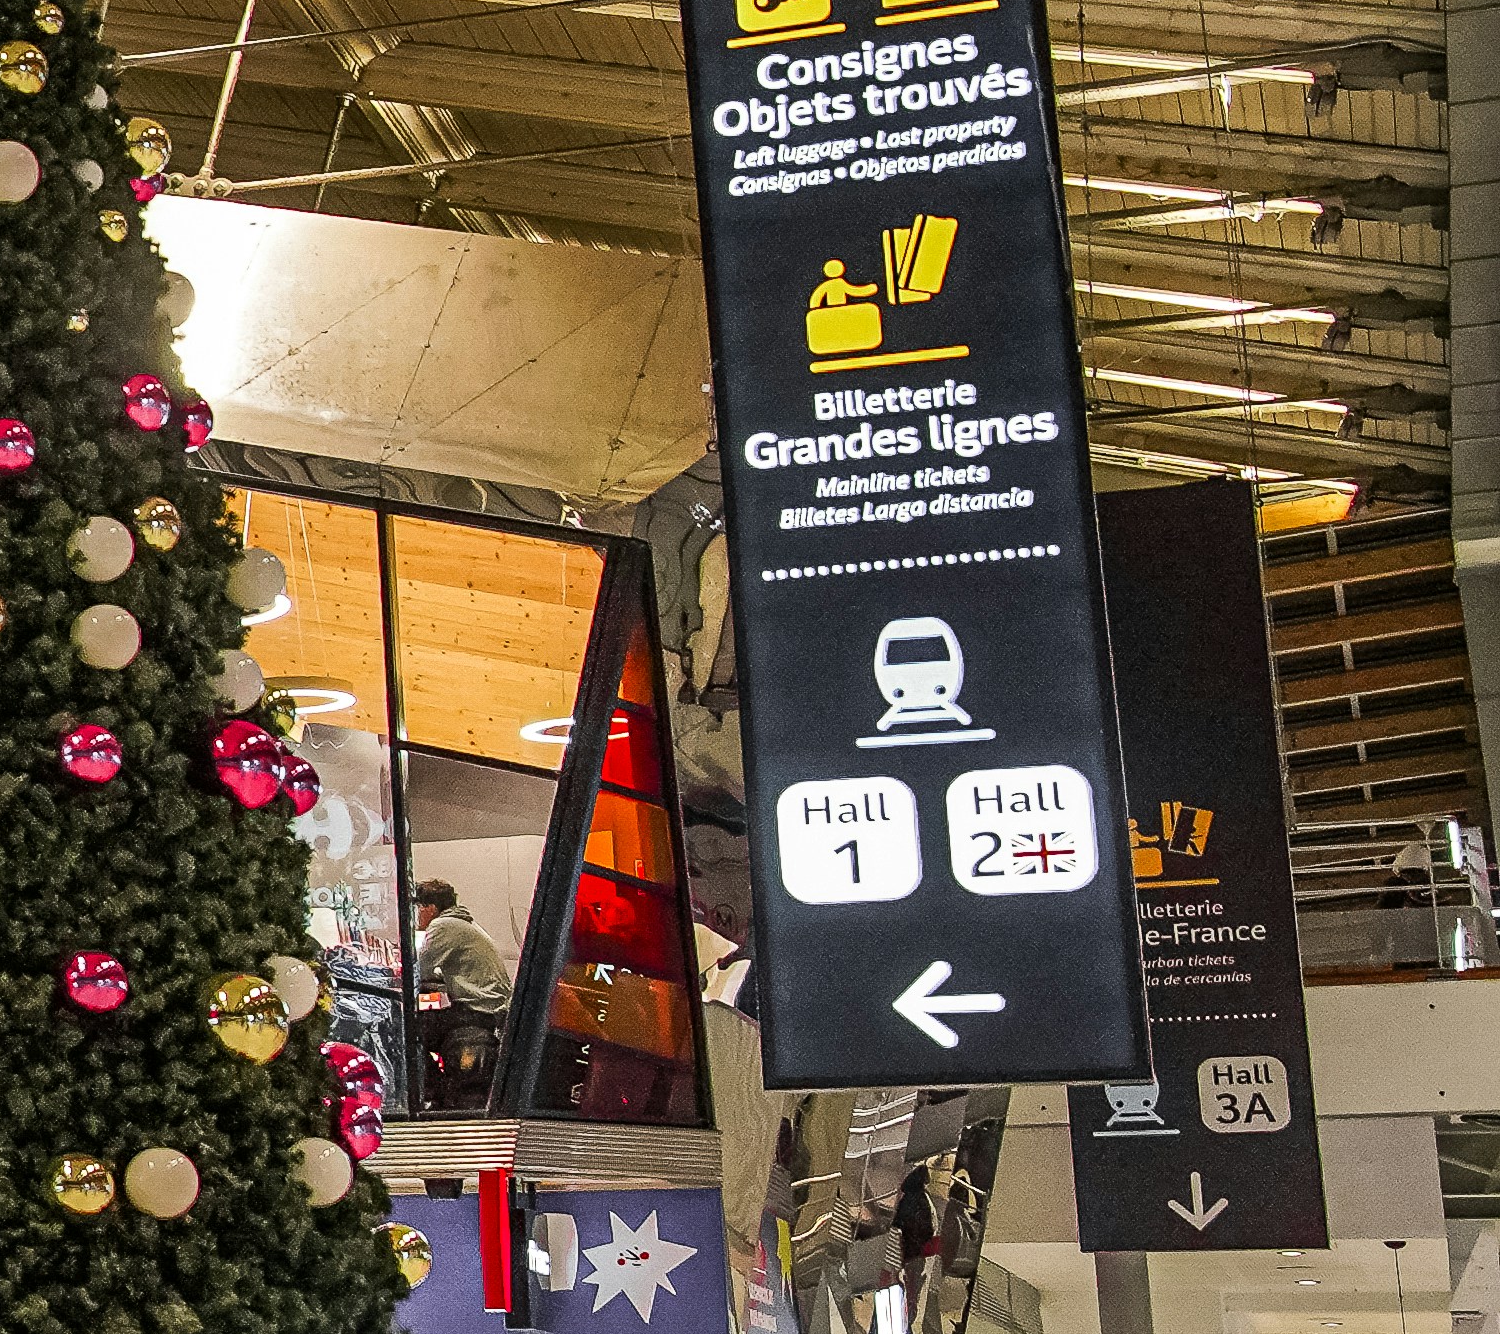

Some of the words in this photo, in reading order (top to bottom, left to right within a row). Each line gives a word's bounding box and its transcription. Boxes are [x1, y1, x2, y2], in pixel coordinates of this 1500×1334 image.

[756, 33, 978, 89] Consignes
[712, 88, 856, 143] Objets
[862, 63, 1032, 119] trouvés
[734, 145, 776, 173] Left
[777, 135, 858, 171] luggage
[875, 127, 923, 149] Lost
[922, 115, 1018, 148] property
[728, 164, 833, 201] Consignas
[850, 152, 930, 185] Objetos
[932, 138, 1026, 173] perdidos
[814, 379, 976, 421] Billetterie
[744, 416, 922, 469] Grandes
[928, 411, 1059, 457] lignes
[816, 472, 912, 501] Mainline
[914, 465, 990, 492] tickets
[779, 500, 860, 529] Billetes
[862, 497, 927, 528] Larga
[929, 487, 1034, 519] distancia
[803, 792, 891, 826] Hall
[972, 780, 1066, 817] Hall
[834, 839, 861, 885] 1
[970, 831, 1006, 878] 2
[1140, 900, 1224, 919] lletterie
[1140, 922, 1267, 945] e-France
[1164, 974, 1181, 985] de
[1188, 952, 1235, 966] tickets
[1212, 1063, 1273, 1087] Hall
[1214, 1091, 1277, 1124] 3A
